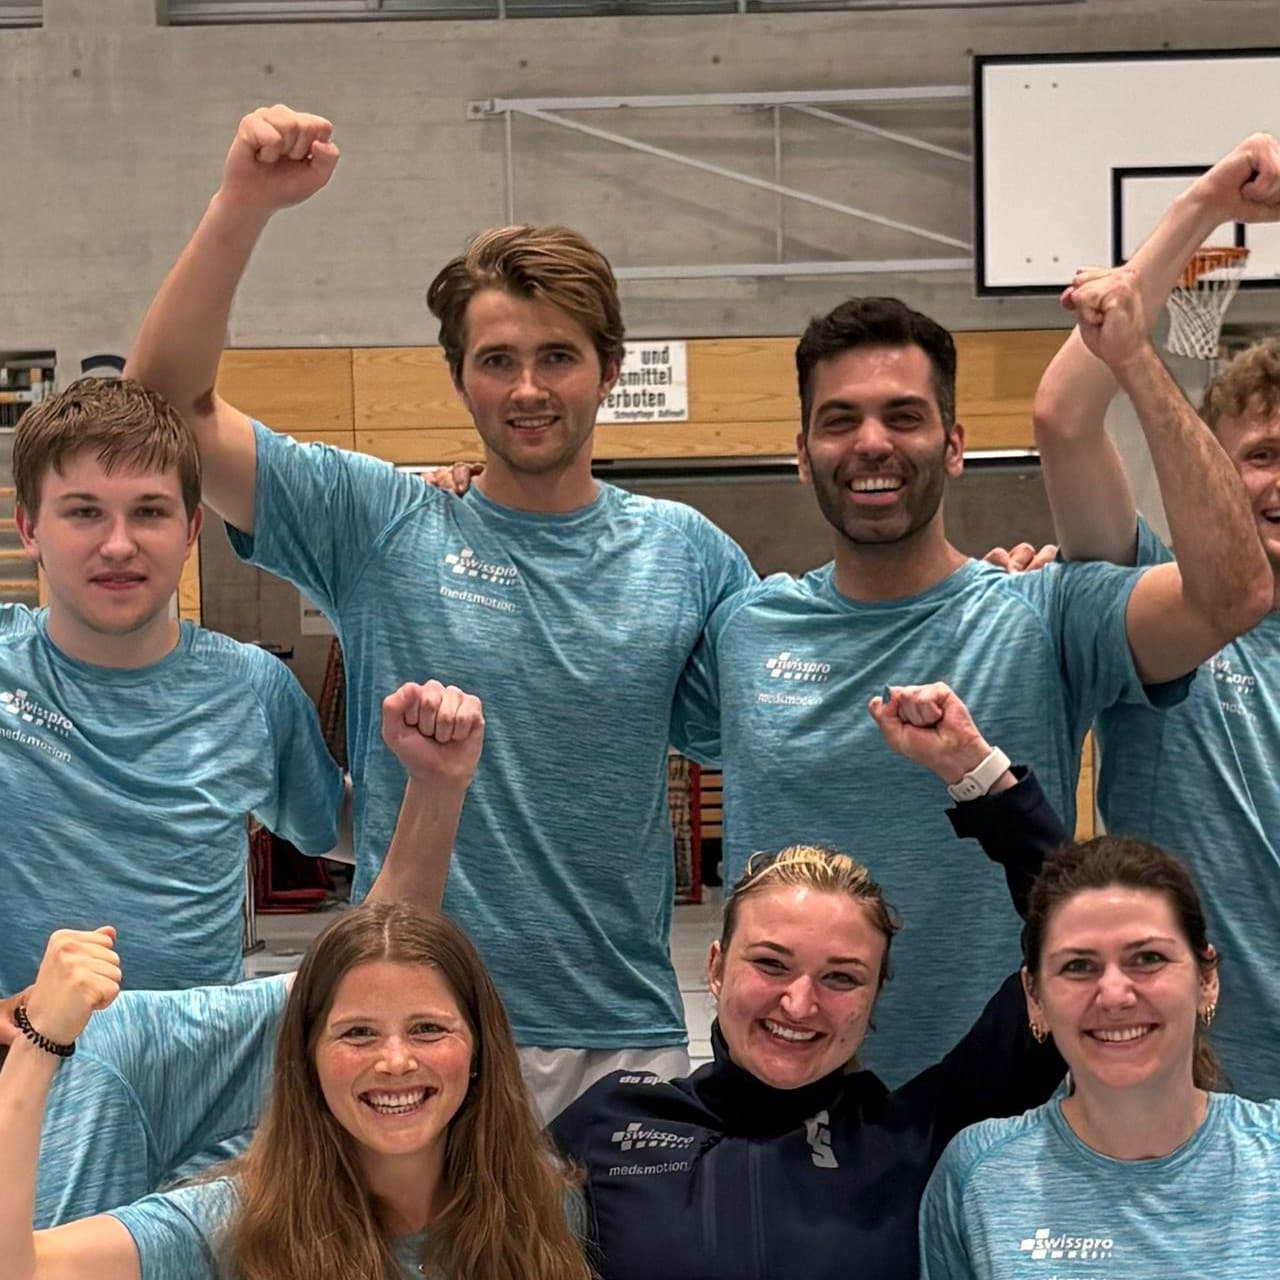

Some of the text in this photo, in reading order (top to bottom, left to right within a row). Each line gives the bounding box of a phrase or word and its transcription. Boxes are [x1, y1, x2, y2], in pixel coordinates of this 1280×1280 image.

[640, 345, 669, 365] und
[618, 366, 673, 386] smittel
[601, 388, 666, 408] erboten
[624, 1128, 695, 1144] swisspro
[1035, 1233, 1114, 1250] swisspro
